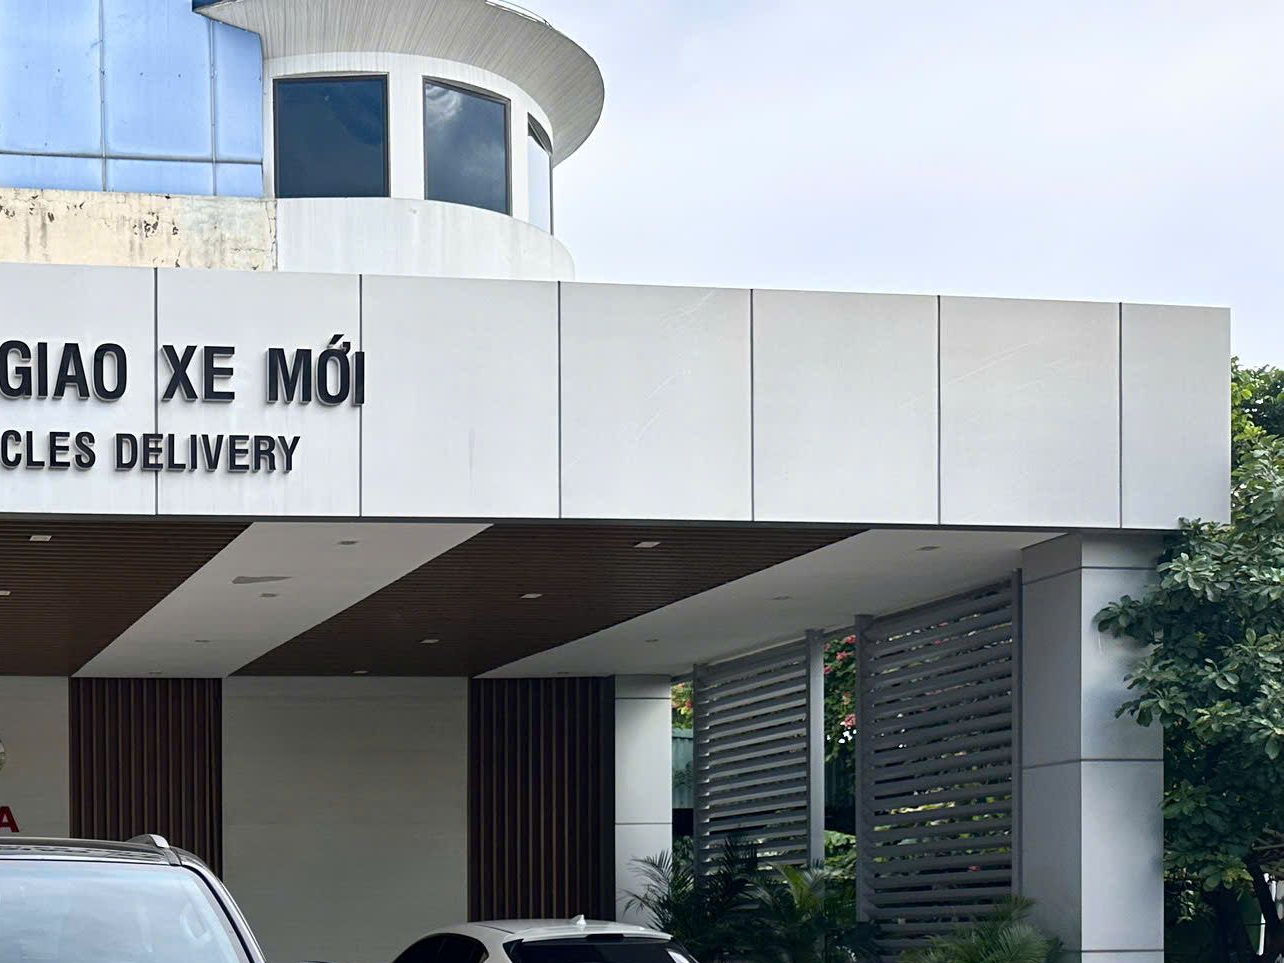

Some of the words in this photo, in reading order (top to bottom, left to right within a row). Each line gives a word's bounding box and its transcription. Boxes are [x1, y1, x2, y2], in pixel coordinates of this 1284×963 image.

[160, 344, 235, 403] XE
[267, 333, 365, 406] MỚI
[116, 432, 300, 473] DELIVERY
